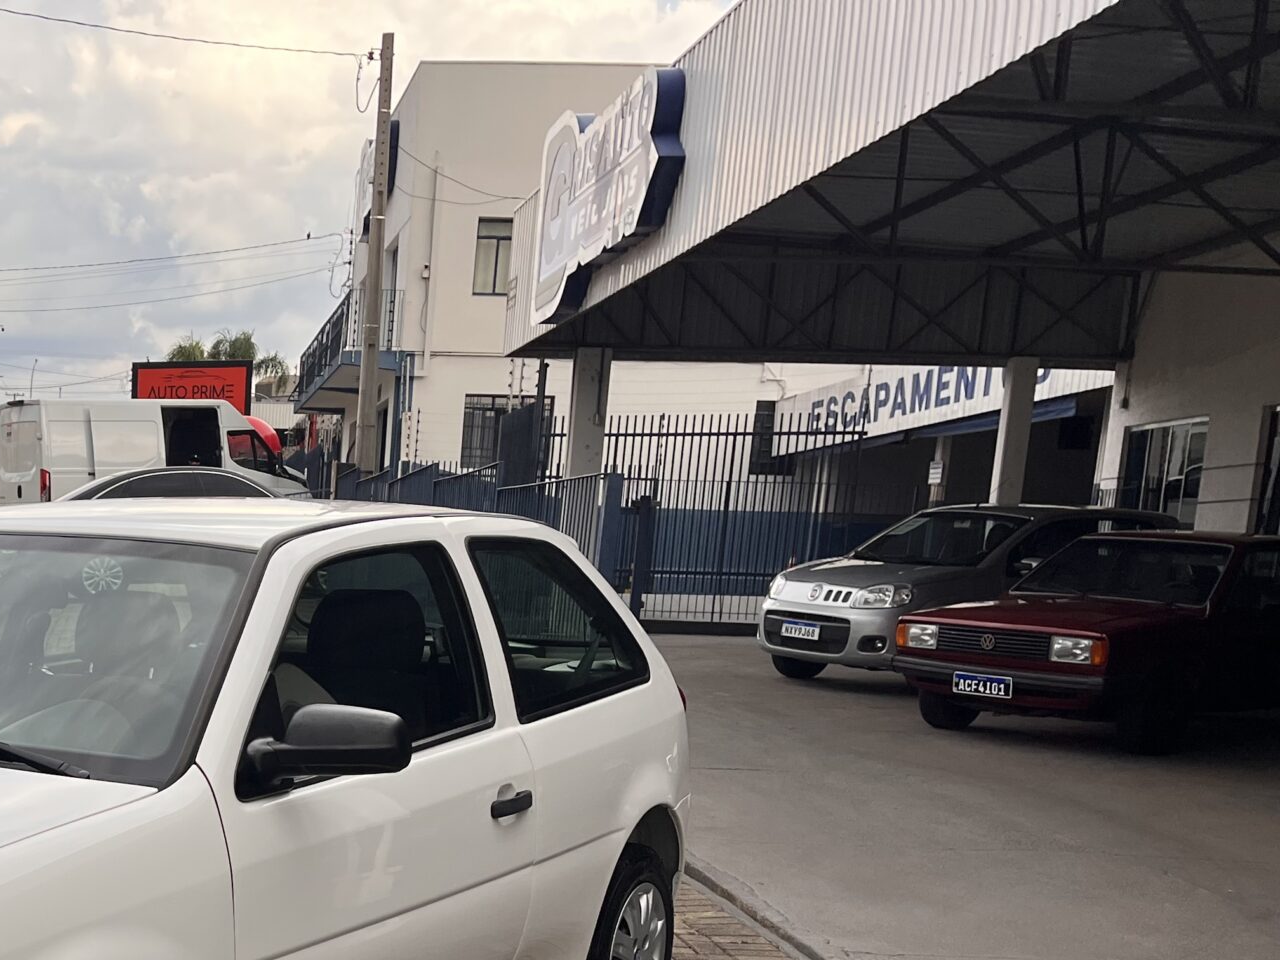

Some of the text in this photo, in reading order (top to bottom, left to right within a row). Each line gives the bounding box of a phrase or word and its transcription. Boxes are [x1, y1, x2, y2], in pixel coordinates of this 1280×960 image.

[148, 383, 234, 399] AUTO PRIME
[810, 366, 1051, 434] ESCAPAMENT
